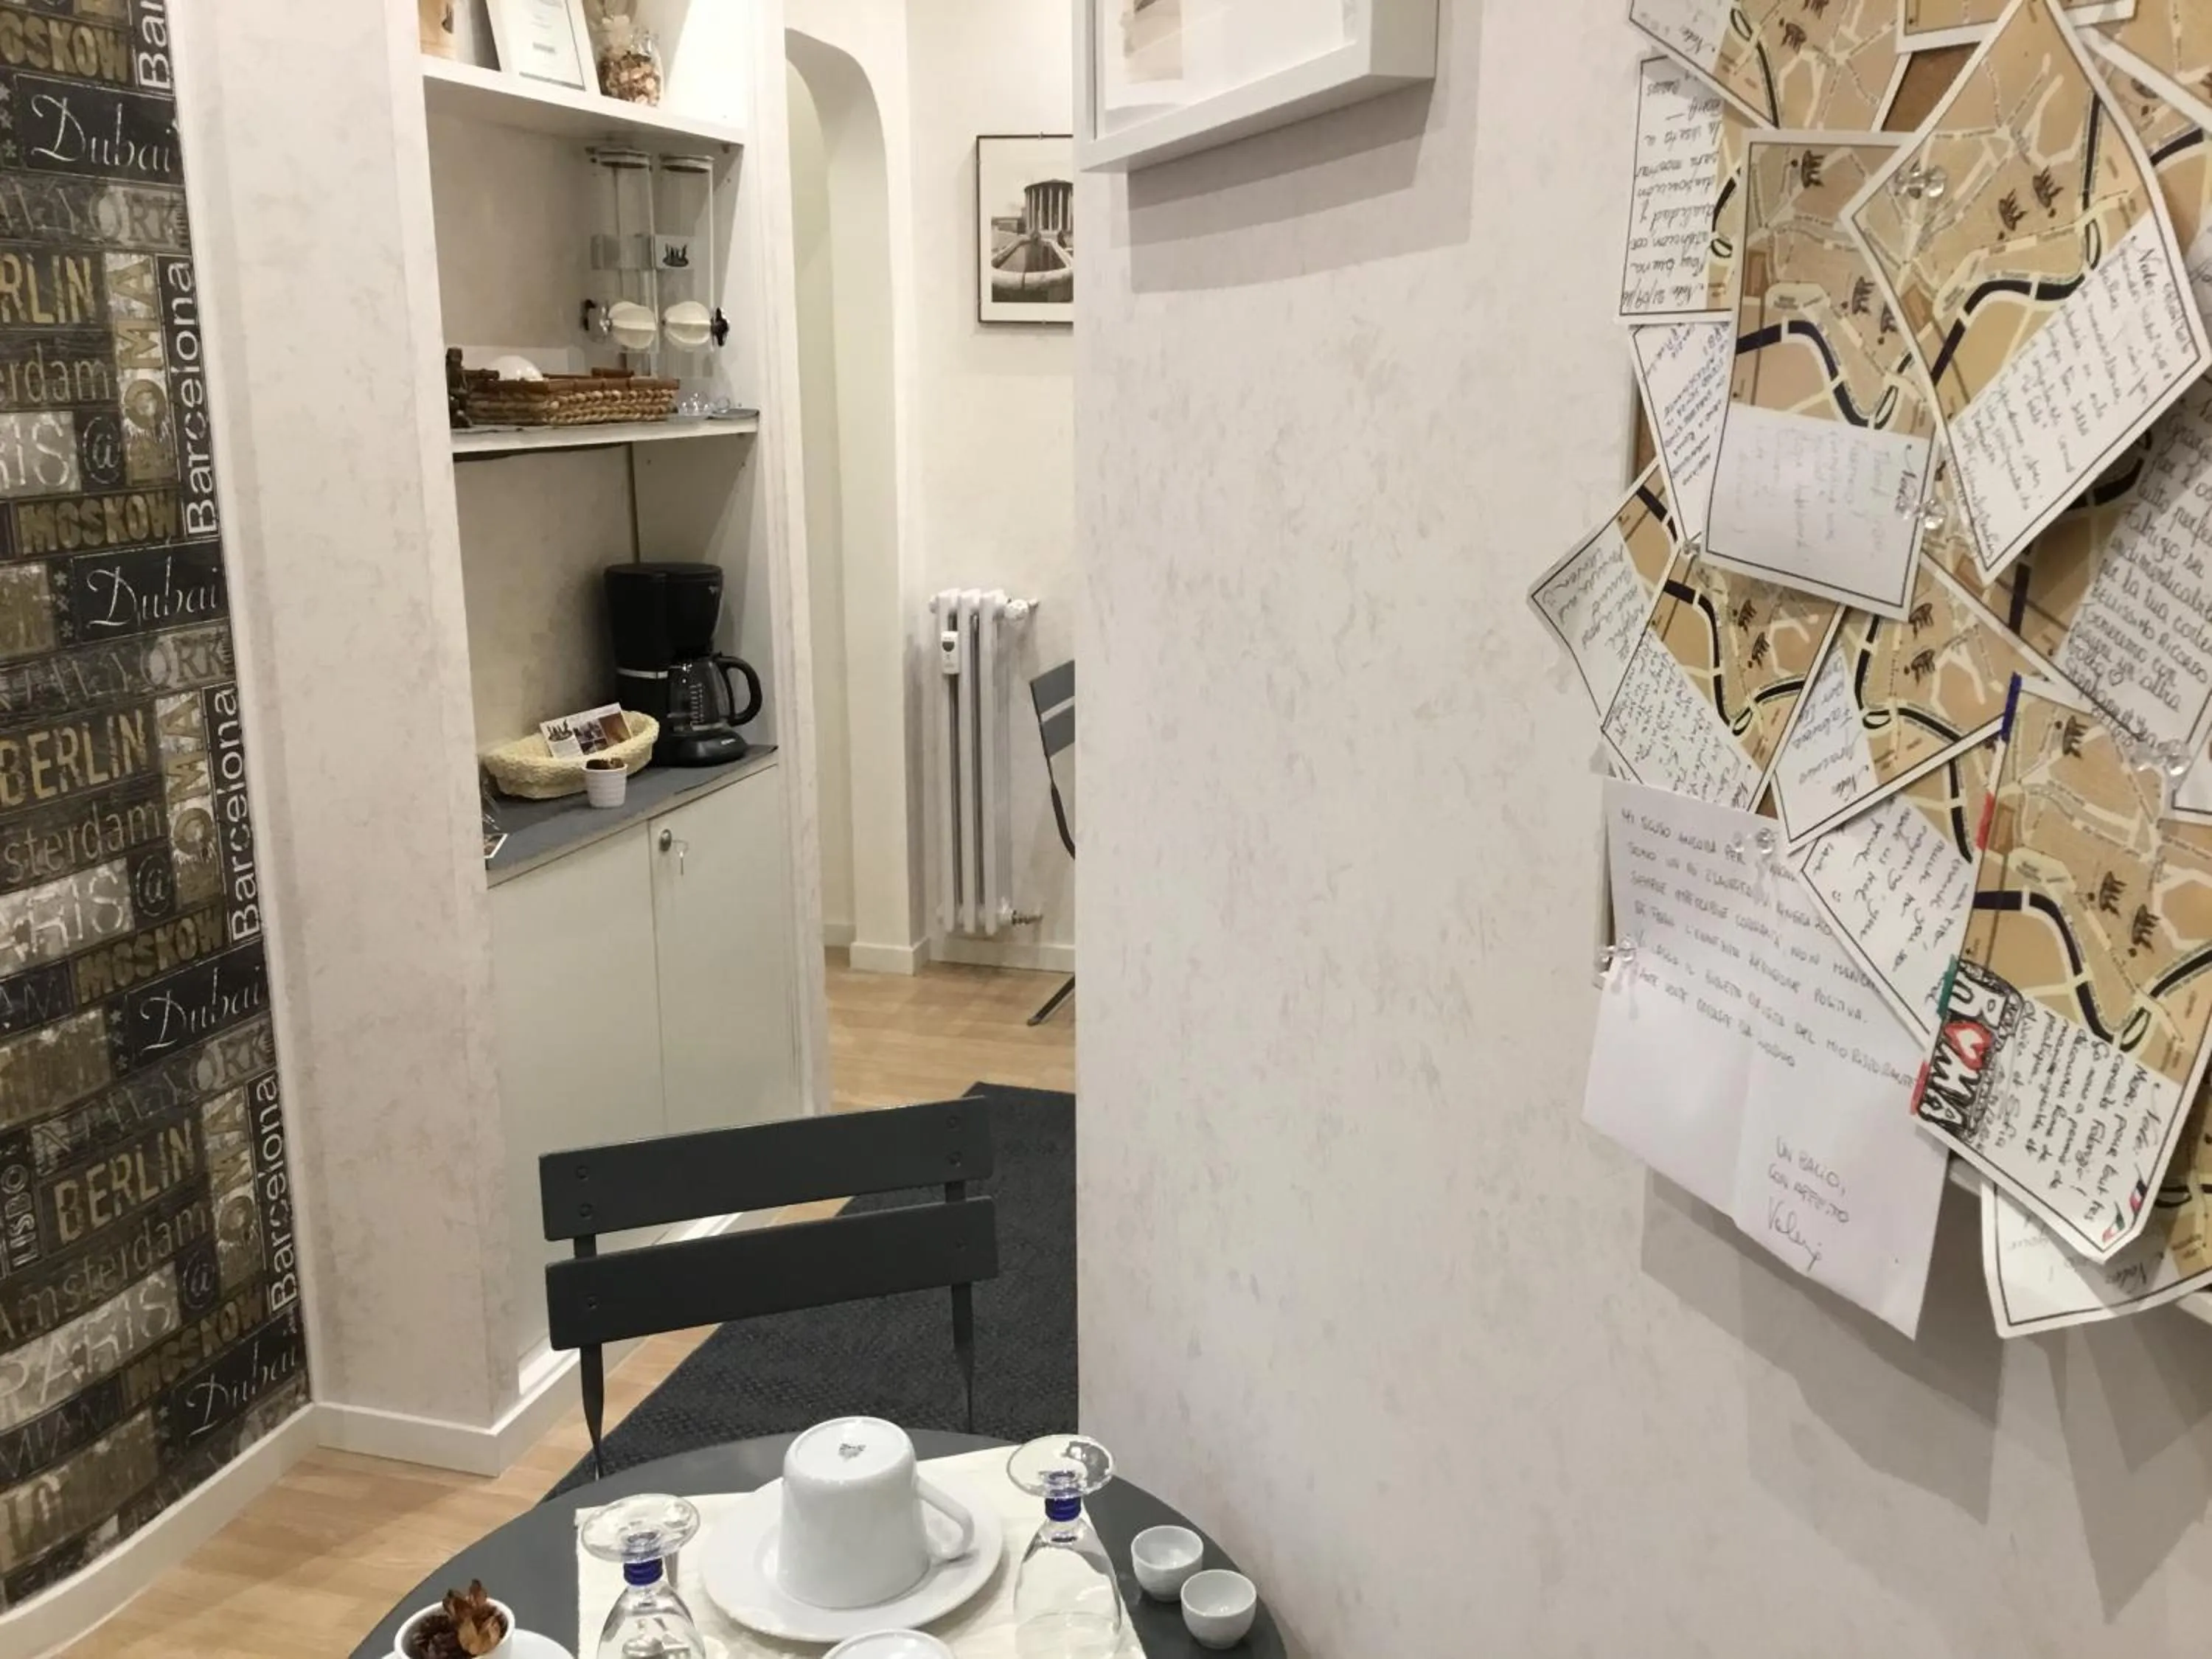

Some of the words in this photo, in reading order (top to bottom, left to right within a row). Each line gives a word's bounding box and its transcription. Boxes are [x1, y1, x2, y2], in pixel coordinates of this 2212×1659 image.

[31, 93, 179, 173] Dubai
[168, 261, 218, 536] Barcelona
[86, 556, 218, 626] Dubai
[215, 689, 260, 941] Barcelona
[141, 965, 260, 1051] Dubai
[55, 1117, 195, 1244] BERLIN
[2106, 1113, 2126, 1157] pour
[256, 1074, 297, 1312] Barcelona
[186, 1330, 295, 1437] Dubai
